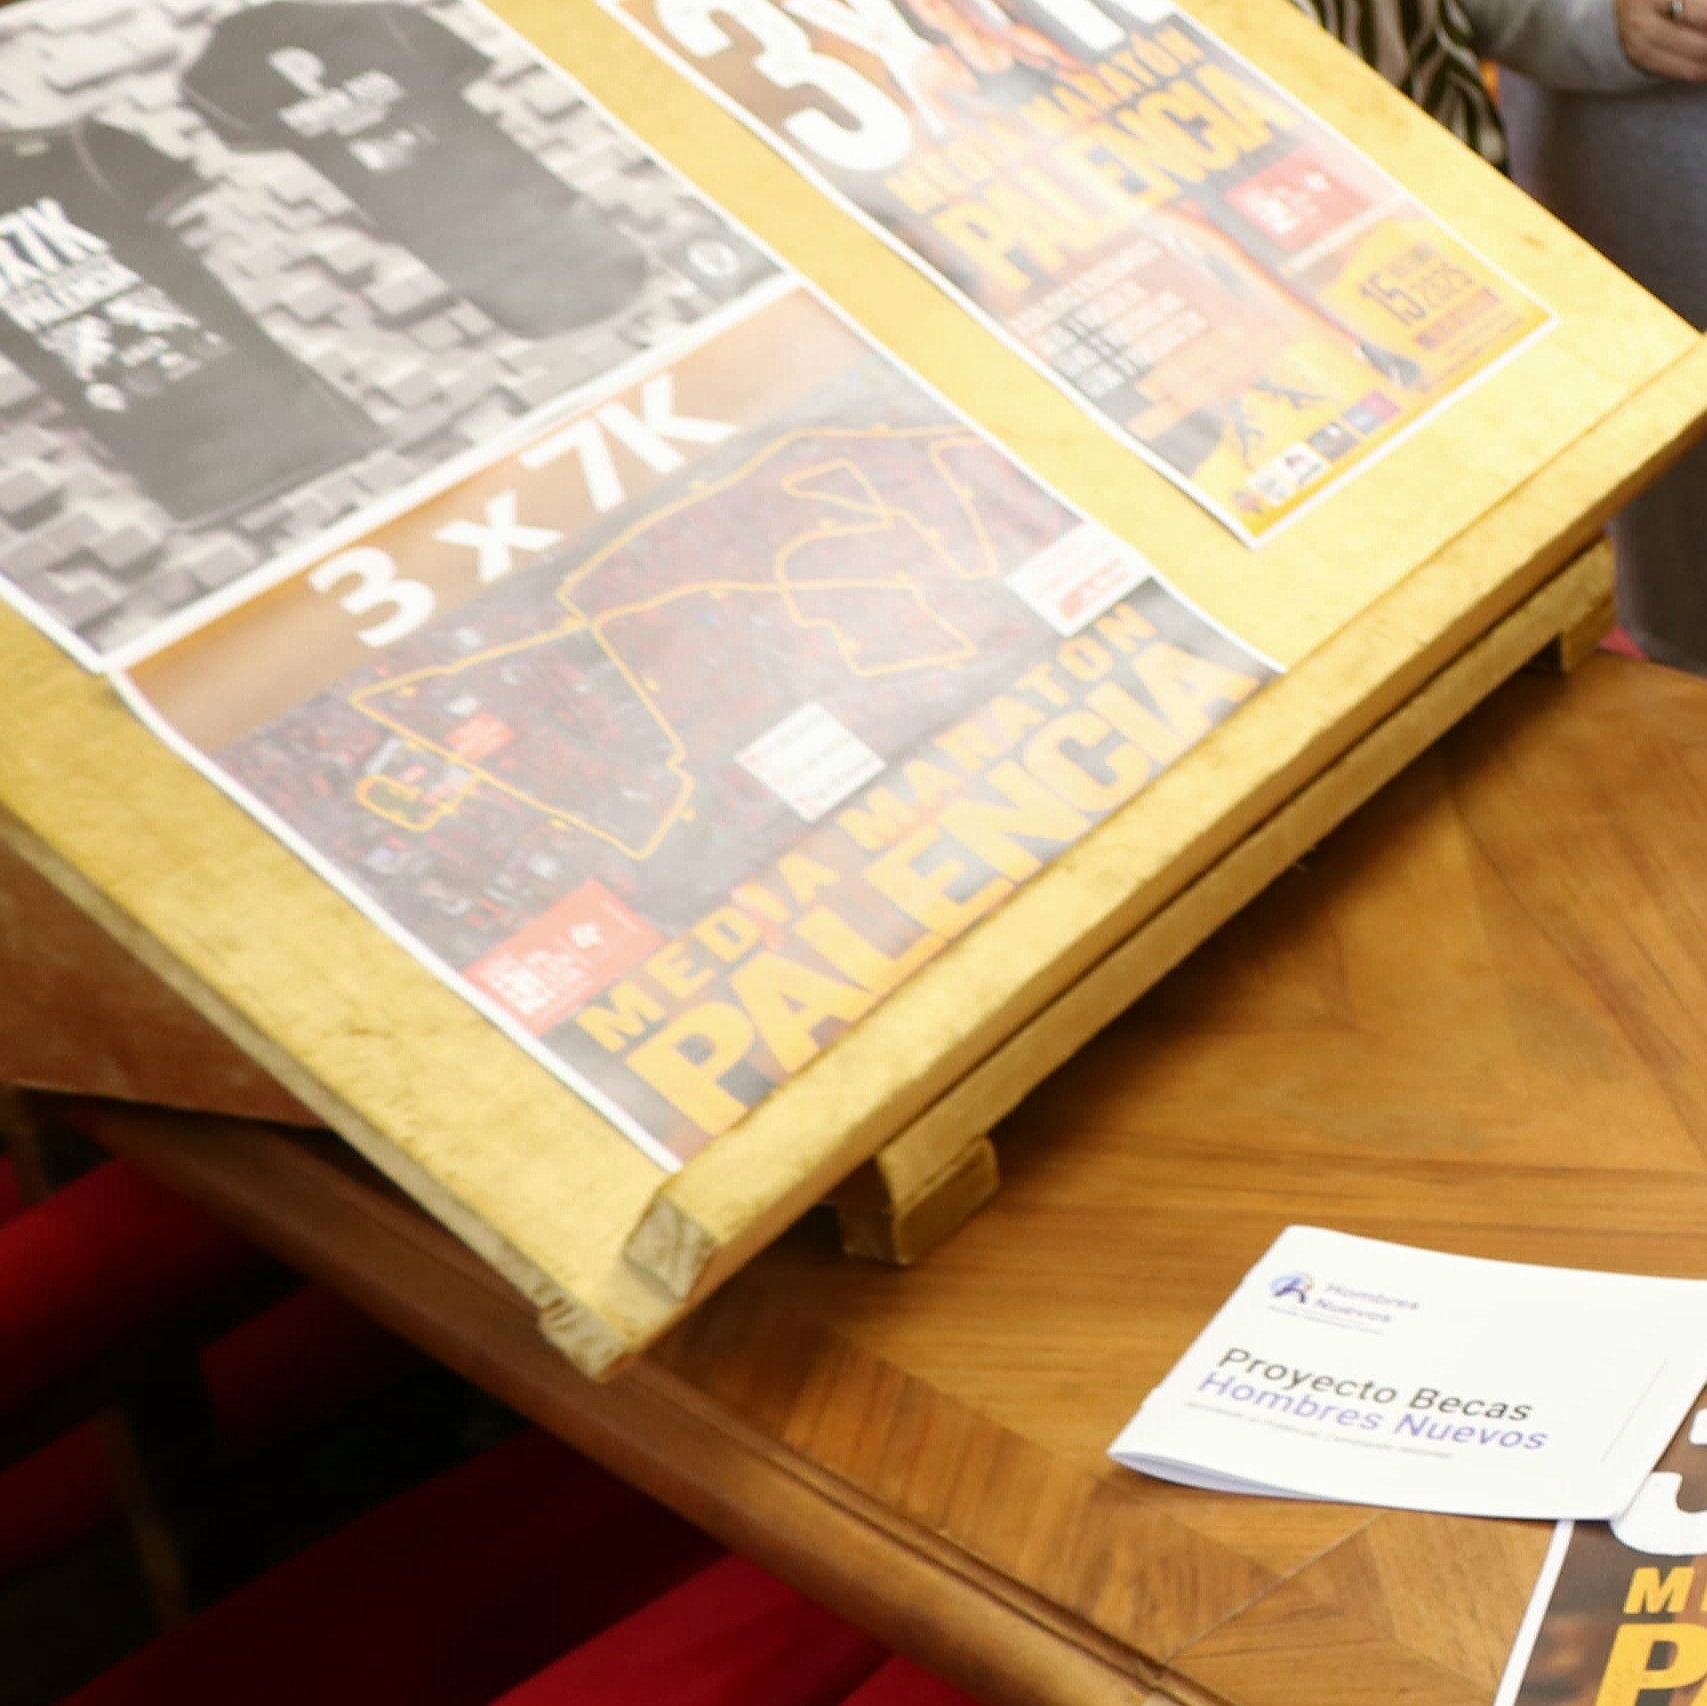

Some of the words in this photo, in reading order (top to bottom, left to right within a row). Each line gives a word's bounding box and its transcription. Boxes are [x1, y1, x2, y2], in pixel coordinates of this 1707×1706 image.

[922, 52, 1305, 297] PALENCIA
[308, 543, 438, 647] 3
[520, 374, 742, 512] 7K
[576, 852, 841, 1052] MEDIA
[624, 643, 1260, 1137] PALENCIA
[1197, 1371, 1384, 1431] Hombres
[1393, 1413, 1549, 1450] Nuevos
[1217, 1347, 1398, 1405] Proyecto
[1408, 1387, 1533, 1422] Becas
